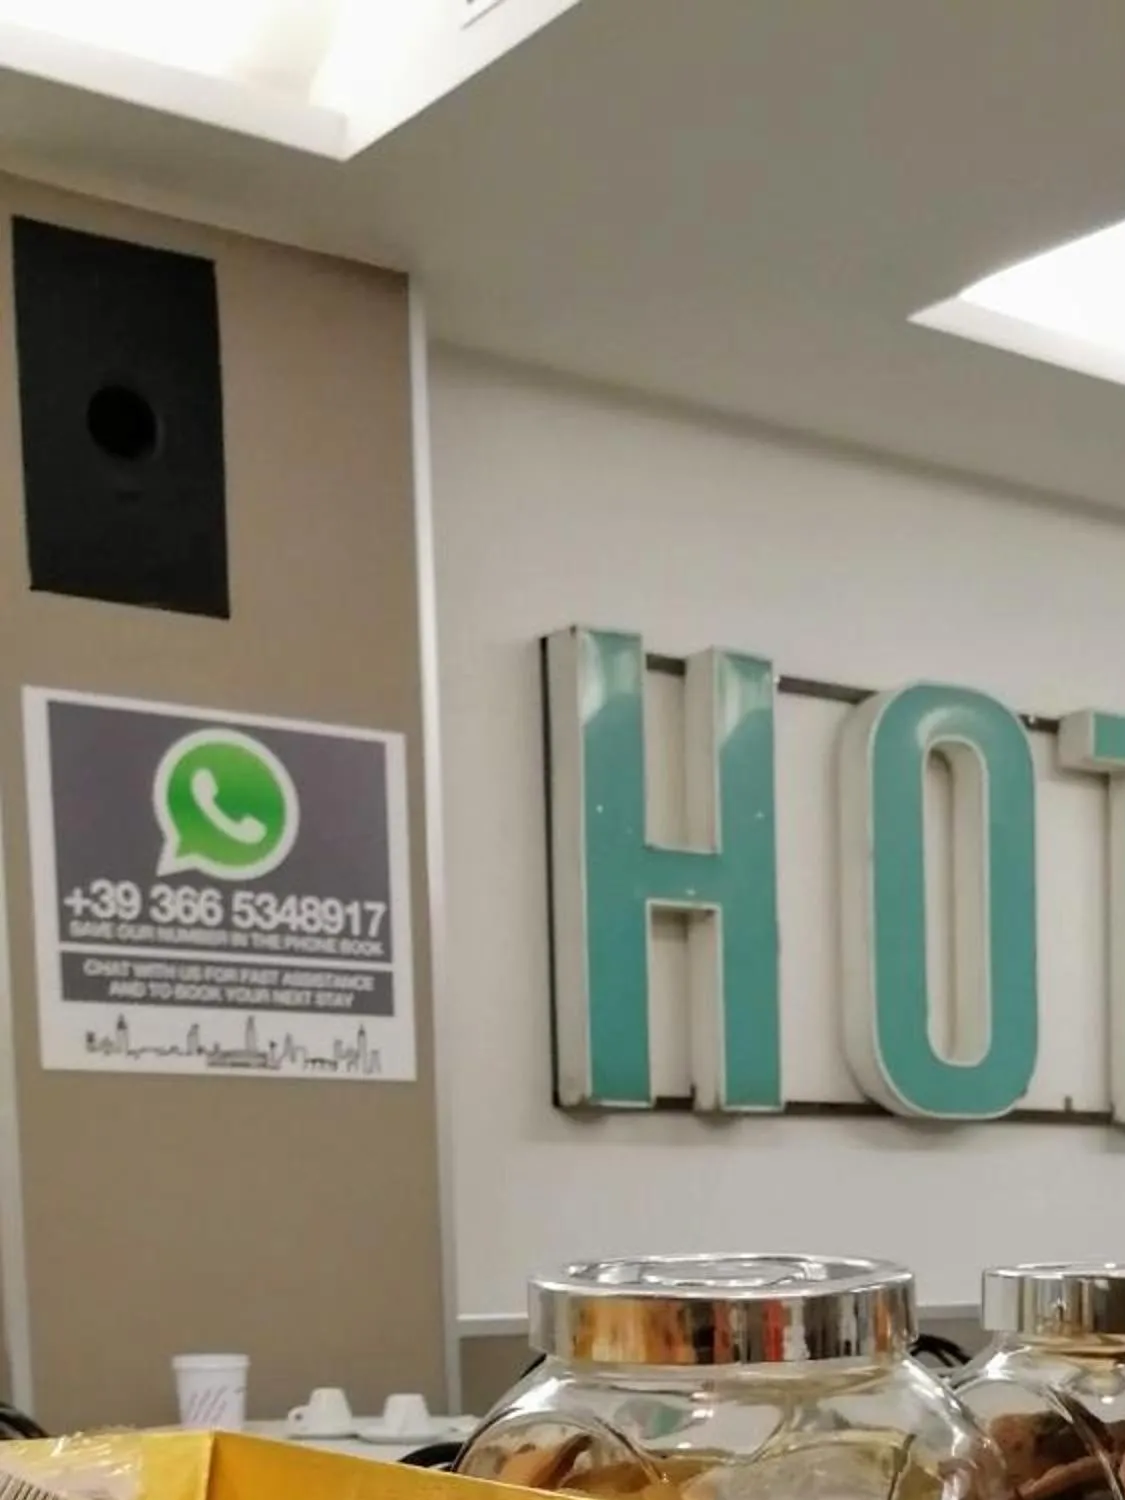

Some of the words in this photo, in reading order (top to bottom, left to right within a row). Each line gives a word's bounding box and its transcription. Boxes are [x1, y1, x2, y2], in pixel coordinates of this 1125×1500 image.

[63, 879, 142, 920] +39
[150, 884, 223, 927] 366
[232, 890, 387, 938] 5348917
[109, 980, 146, 997] AND
